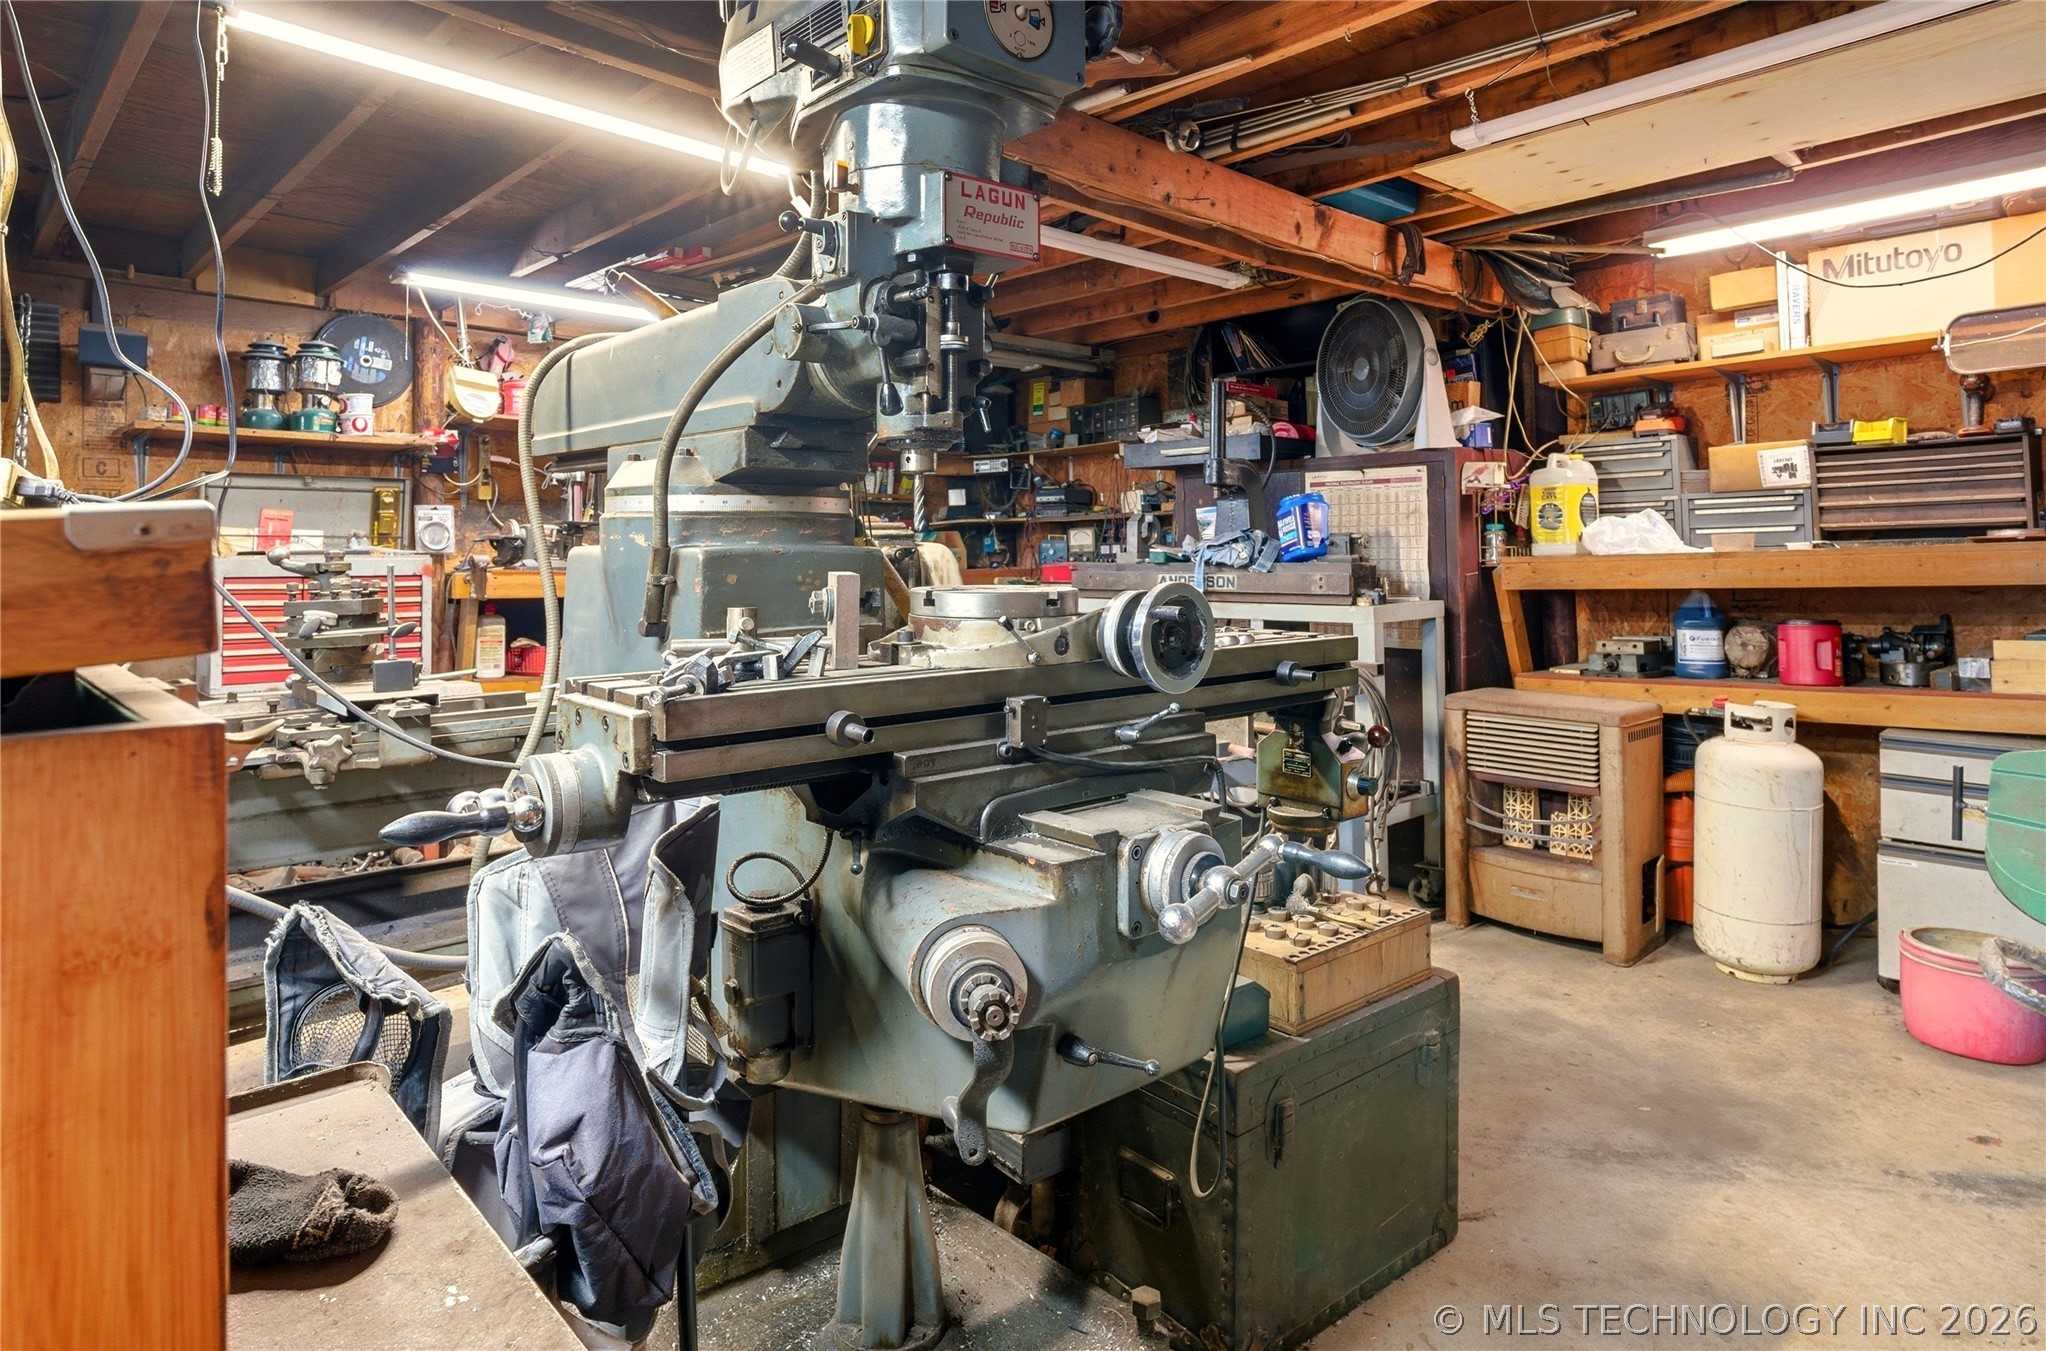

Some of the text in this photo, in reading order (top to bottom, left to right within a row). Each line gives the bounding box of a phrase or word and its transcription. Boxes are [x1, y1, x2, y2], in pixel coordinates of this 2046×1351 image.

[961, 181, 1025, 211] LAGUN
[964, 205, 1025, 230] Republic
[1822, 243, 1963, 280] Mitutoyo
[95, 461, 107, 476] C
[1159, 575, 1236, 589] ANDESON
